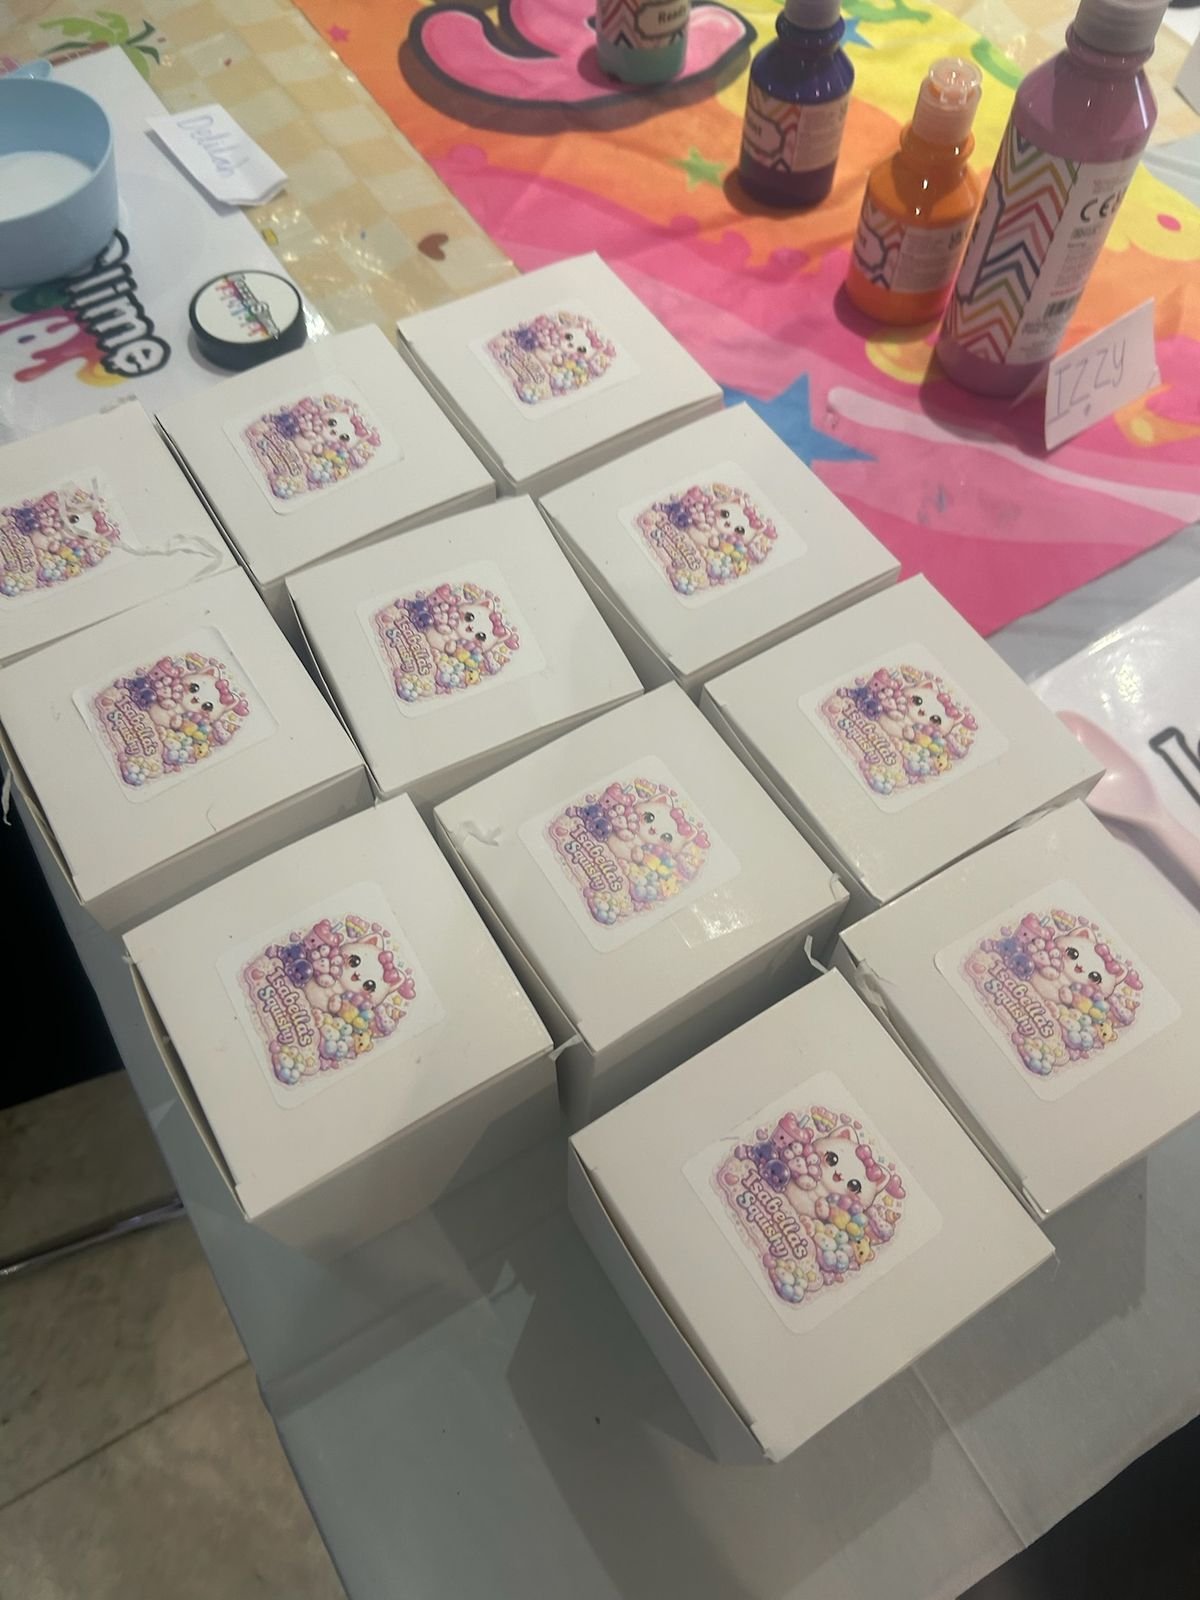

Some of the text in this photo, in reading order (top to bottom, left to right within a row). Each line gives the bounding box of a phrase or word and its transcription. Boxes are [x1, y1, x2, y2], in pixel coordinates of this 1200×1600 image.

[385, 628, 415, 674] Squishy
[393, 614, 433, 676] Isabella's
[107, 709, 140, 755] Squishy
[114, 694, 158, 757] Isabella's
[842, 704, 897, 766] Isabella's
[564, 839, 606, 890] Squishy
[569, 823, 624, 892] Isabella's
[257, 985, 295, 1044] Squishy
[265, 966, 315, 1047] Isabella's
[983, 979, 1036, 1036] Squishy
[988, 959, 1055, 1038] Isabella's
[736, 1190, 789, 1257] Squishy
[741, 1167, 808, 1260] Isabella's
